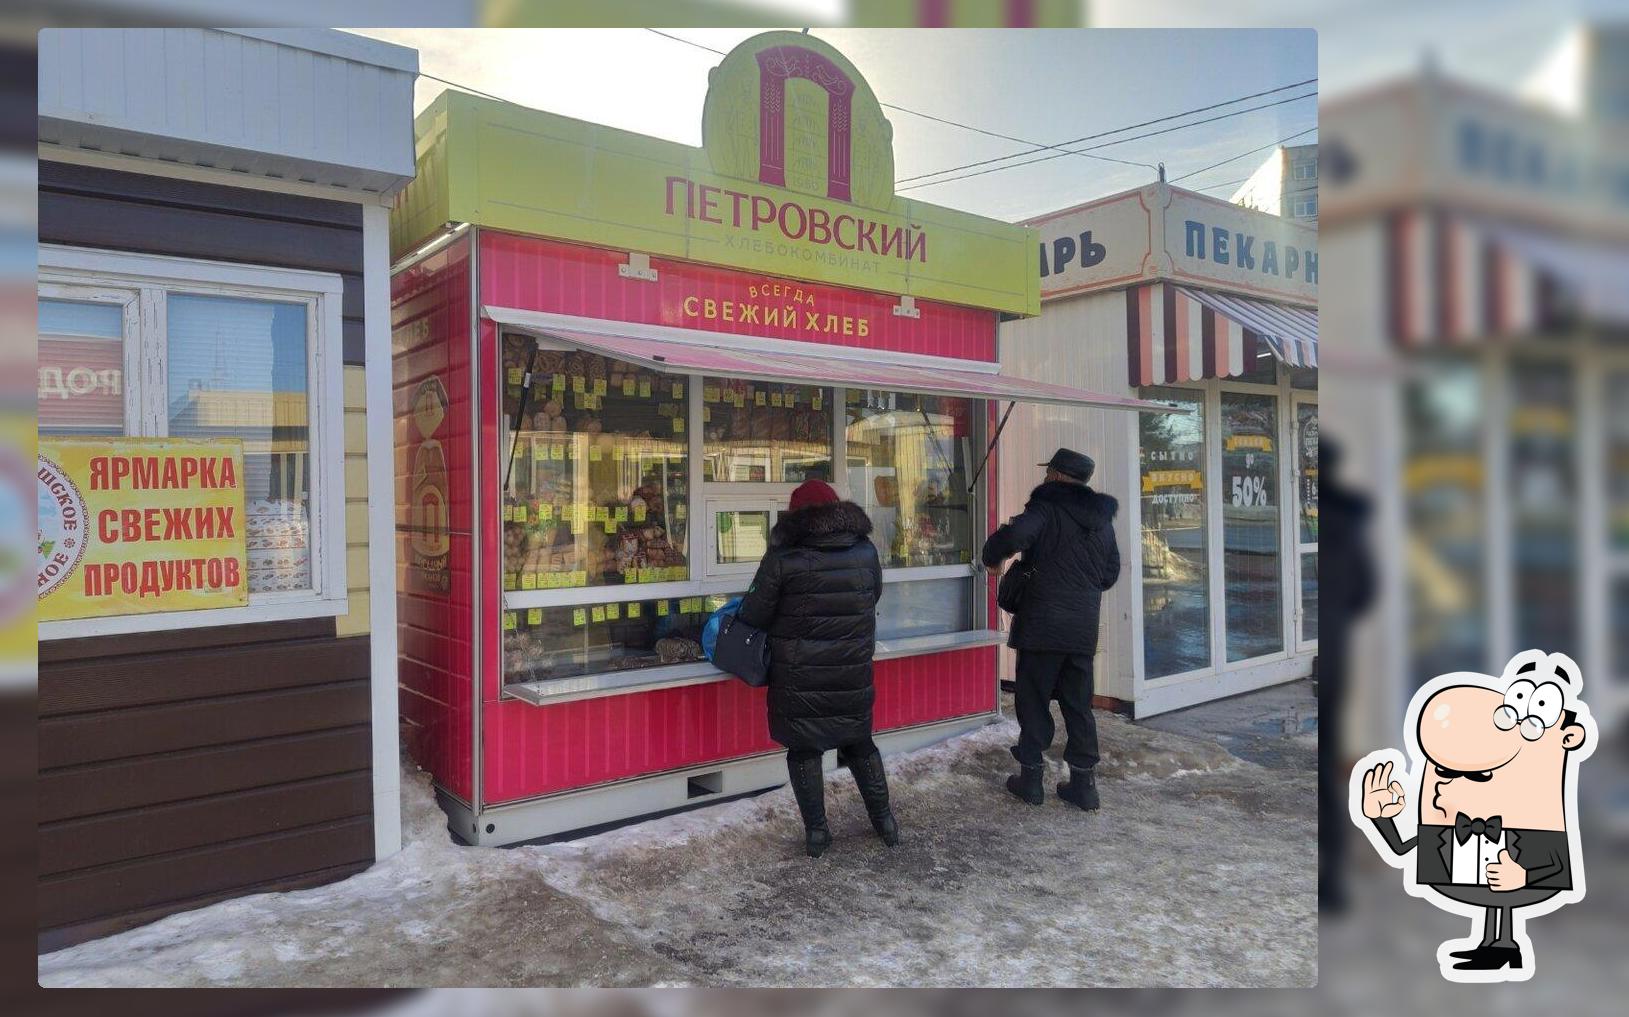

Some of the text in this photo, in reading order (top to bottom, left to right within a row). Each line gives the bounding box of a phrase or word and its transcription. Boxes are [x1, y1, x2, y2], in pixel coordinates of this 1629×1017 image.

[665, 176, 927, 263] ПЕТРОВСКИЙ
[726, 234, 881, 273] ХЛЕБОКОМБИНАТ
[1185, 220, 1318, 285] ПЕКАРН
[749, 283, 816, 306] ВСЕГДА
[683, 296, 869, 337] СВЕЖИЙ ХЛЕБ
[90, 456, 237, 492] ЯРМАРКА
[1150, 450, 1194, 461] СЫТНО
[1232, 475, 1267, 508] 50%
[98, 506, 235, 544] СВЕЖИХ
[84, 557, 240, 598] ПРОДУКТОВ
